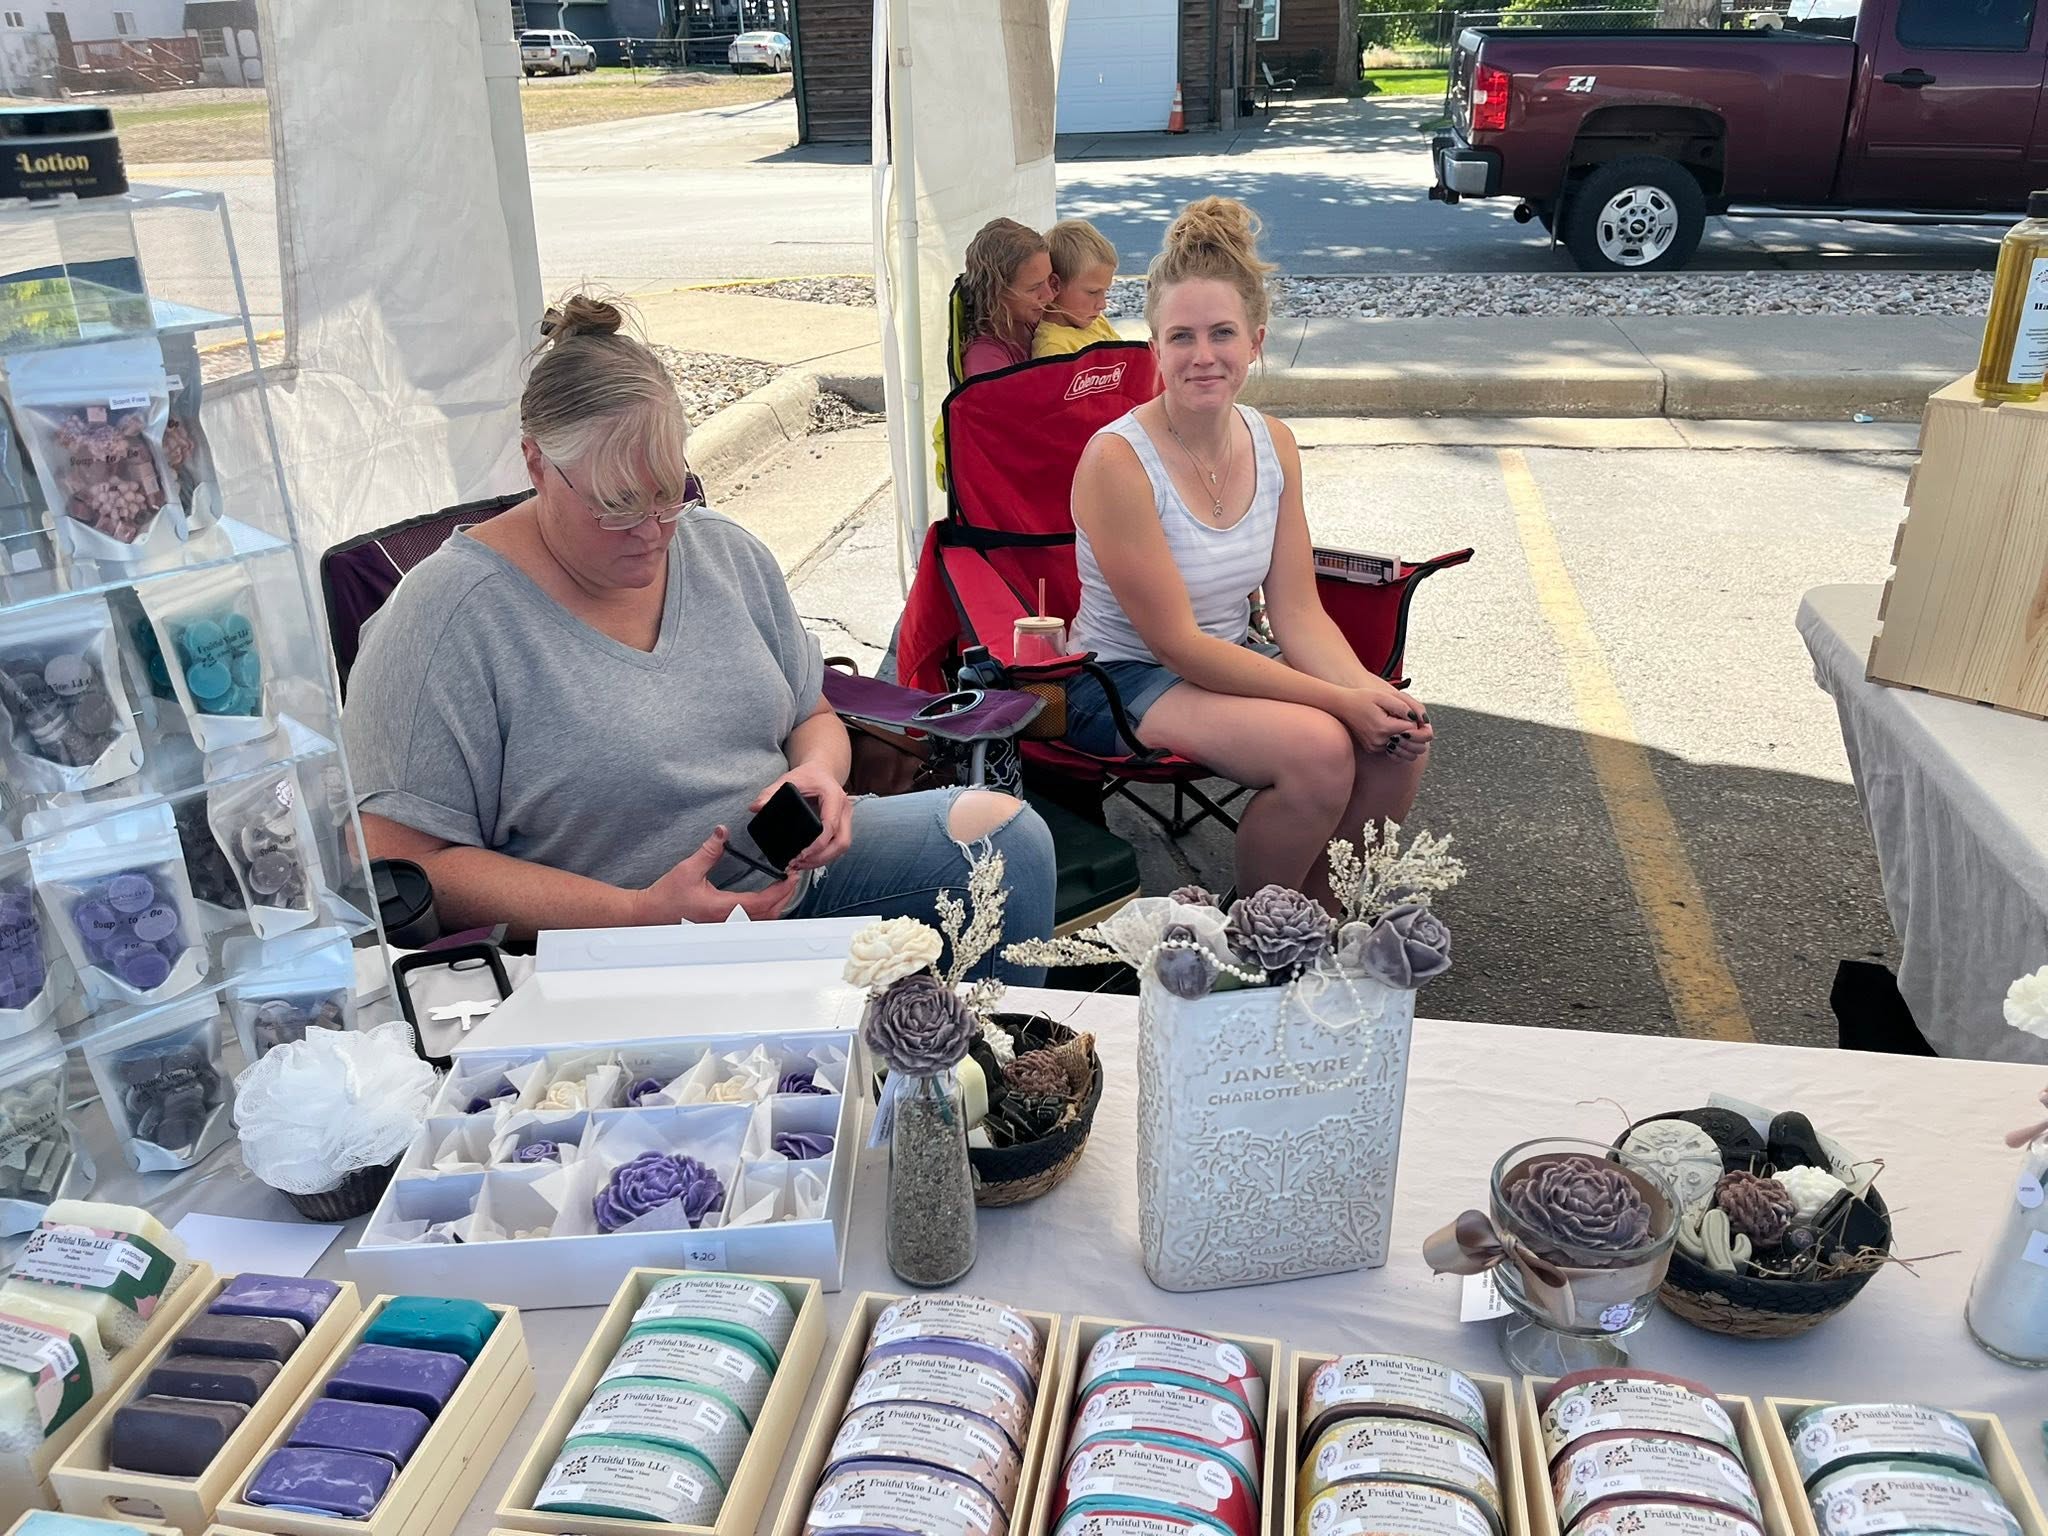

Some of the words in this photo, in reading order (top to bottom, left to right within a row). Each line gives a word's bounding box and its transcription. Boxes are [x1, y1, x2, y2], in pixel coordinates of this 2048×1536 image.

[16, 152, 89, 173] Lotion
[1073, 373, 1112, 392] Coleman
[93, 920, 116, 931] Soap
[128, 917, 138, 925] to
[1221, 1064, 1285, 1084] JANE
[1295, 1056, 1350, 1076] EYRE
[1208, 1086, 1301, 1105] CHARLOTTE
[49, 1234, 77, 1246] Fruitful
[77, 1239, 93, 1248] Vine
[94, 1240, 113, 1250] LLC
[685, 1281, 714, 1289] Fruitful
[733, 1283, 753, 1291] LLC
[955, 1301, 973, 1309] Vine
[975, 1303, 995, 1313] LLC
[648, 1339, 677, 1347] Fruitful
[679, 1340, 695, 1348] Vine
[697, 1343, 718, 1353] LLC
[1140, 1331, 1170, 1339] Fruitful
[1172, 1333, 1190, 1342] Vine
[1192, 1336, 1212, 1347] LLC
[905, 1359, 936, 1367] Fruitful
[937, 1361, 956, 1370] Vine
[958, 1363, 979, 1374] LLC
[1370, 1359, 1403, 1369] Fruitful
[1405, 1362, 1424, 1372] Vine
[1426, 1367, 1448, 1379] LLC
[980, 1377, 1011, 1400] Lavender
[1133, 1389, 1165, 1398] Fruitful
[1166, 1391, 1186, 1400] Vine
[1188, 1395, 1209, 1406] LLC
[1616, 1385, 1651, 1395] Fruitful
[1652, 1387, 1673, 1397] Vine
[1676, 1391, 1698, 1401] LLC
[623, 1393, 655, 1401] Fruitful
[656, 1394, 674, 1402] Vine
[675, 1397, 696, 1407] LLC
[889, 1410, 921, 1420] Fruitful
[922, 1413, 941, 1423] Vine
[942, 1418, 964, 1430] LLC
[1855, 1411, 1891, 1419] Fruitful
[1891, 1411, 1913, 1419] Vine
[969, 1430, 1000, 1455] Lavender
[1374, 1429, 1408, 1438] Fruitful
[1410, 1432, 1430, 1441] Vine
[1432, 1436, 1454, 1447] LLC
[1118, 1449, 1152, 1460] Fruitful
[1154, 1454, 1174, 1465] Vine
[1176, 1458, 1198, 1470] LLC
[1631, 1445, 1667, 1454] Fruitful
[1669, 1447, 1691, 1457] Vine
[1693, 1450, 1714, 1463] LLC
[591, 1455, 625, 1464] Fruitful
[626, 1456, 646, 1467] Vine
[648, 1460, 670, 1473] LLC
[870, 1479, 903, 1489] Fruitful
[905, 1481, 925, 1492] Vine
[927, 1486, 951, 1498] LLC
[1888, 1481, 1925, 1491] Fruitful
[1926, 1483, 1949, 1492] Vine
[1368, 1489, 1403, 1499] Fruitful
[1405, 1491, 1427, 1502] Vine
[1429, 1494, 1452, 1507] LLC
[959, 1500, 990, 1527] Lavender
[1644, 1510, 1682, 1520] Fruitful
[1683, 1512, 1706, 1522] Vine
[1709, 1515, 1731, 1528] LLC
[1104, 1518, 1140, 1528] Fruitful
[1142, 1520, 1163, 1531] Vine
[1166, 1524, 1188, 1536] LLC
